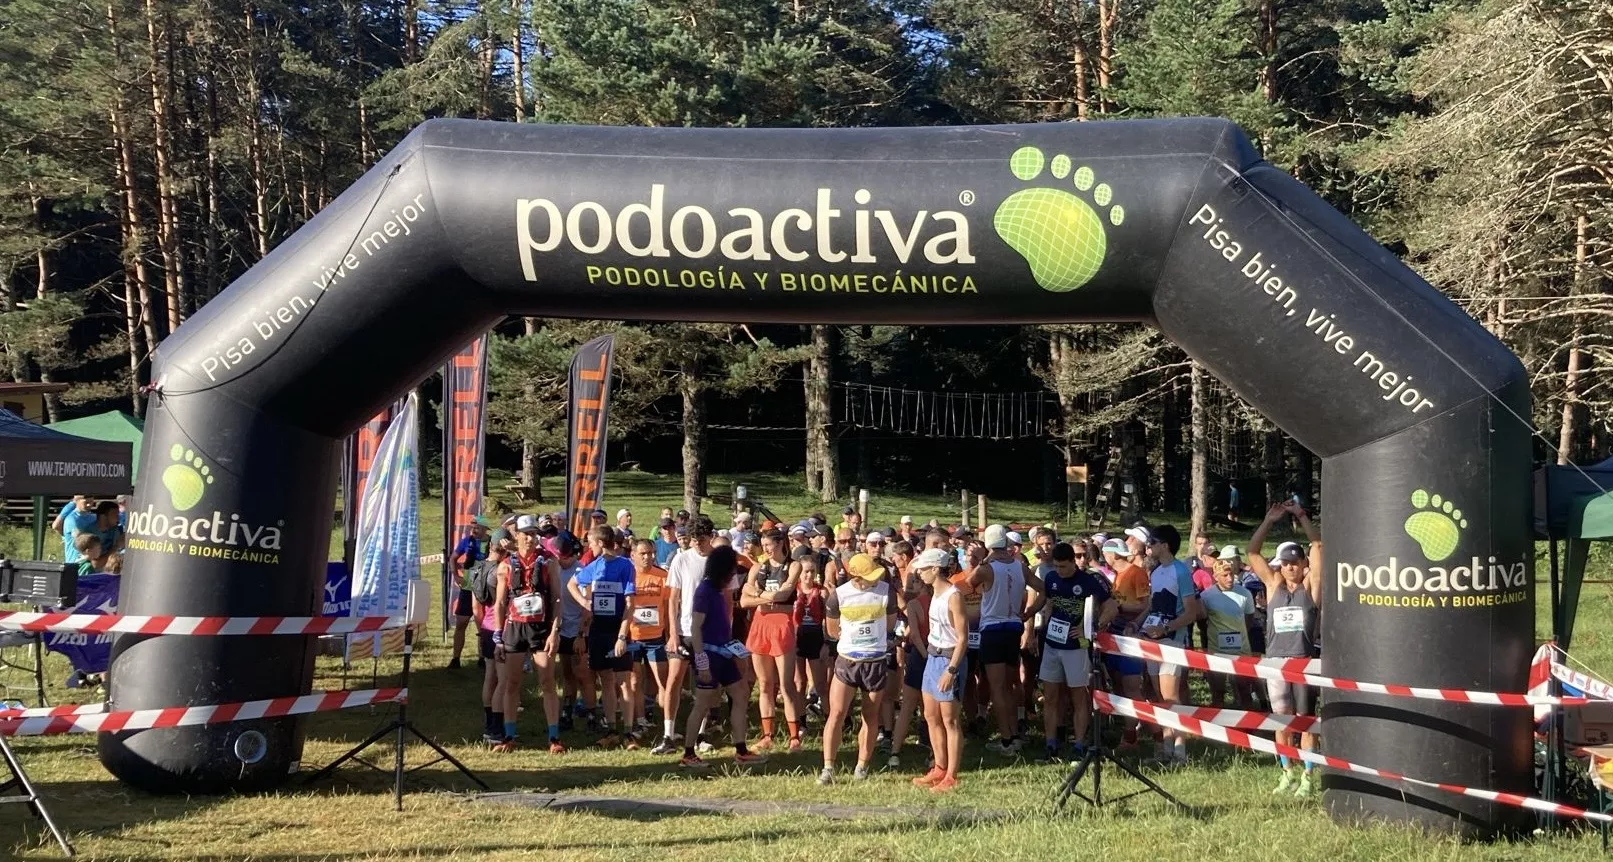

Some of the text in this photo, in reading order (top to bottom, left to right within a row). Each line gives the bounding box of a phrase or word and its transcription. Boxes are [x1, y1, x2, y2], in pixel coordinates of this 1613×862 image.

[586, 265, 978, 294] PODOLOGÍA Y BIOMECÁNICA
[199, 193, 427, 382] Pisa bien, vive mejor
[1188, 203, 1434, 414] Pisa bien, vive mejor
[27, 460, 126, 478] WWW.TEMPOFINITO.COM
[178, 543, 186, 554] Y
[188, 544, 280, 565] BIOMECÁNICA
[525, 599, 531, 607] 9
[599, 599, 609, 607] 65
[1358, 590, 1528, 608] PODOLOGÍA Y BIOMECÁNICA
[640, 610, 652, 618] 48
[858, 626, 871, 635] 58
[1051, 623, 1063, 634] 136
[1225, 635, 1235, 644] 91
